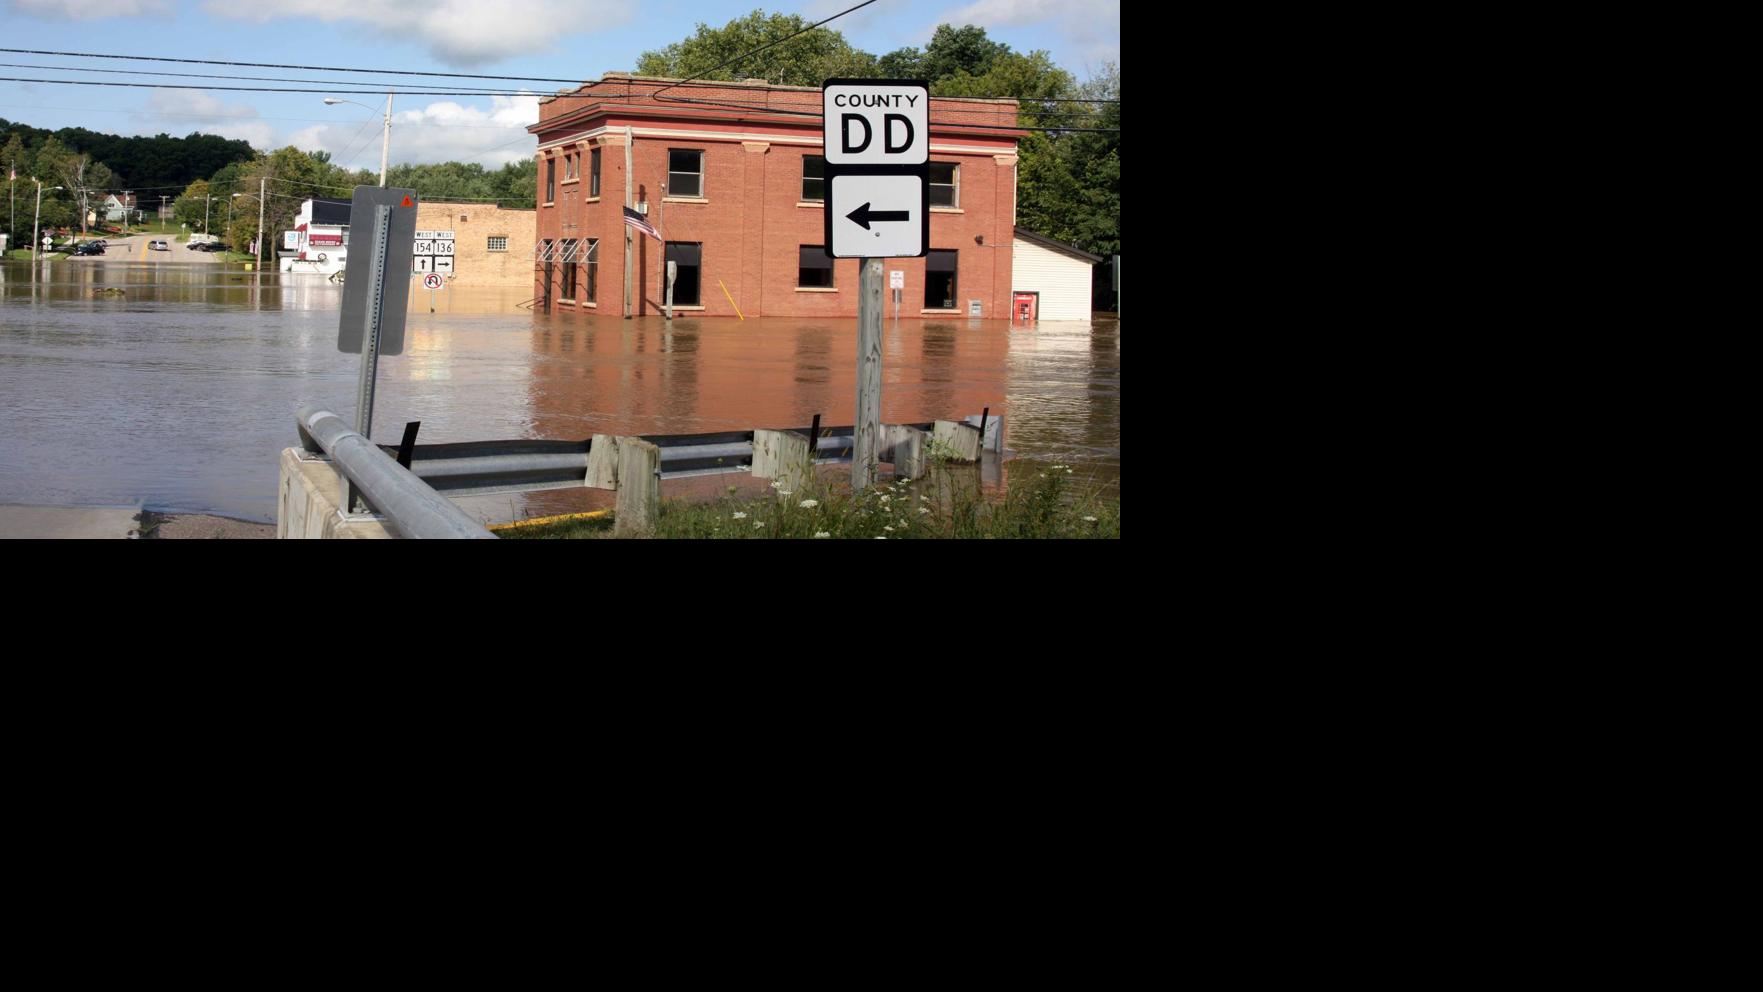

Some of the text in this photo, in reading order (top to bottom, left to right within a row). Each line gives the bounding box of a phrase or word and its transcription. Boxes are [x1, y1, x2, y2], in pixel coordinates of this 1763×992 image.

[834, 94, 919, 108] COUNTY
[416, 243, 431, 252] 154
[437, 243, 452, 252] 136
